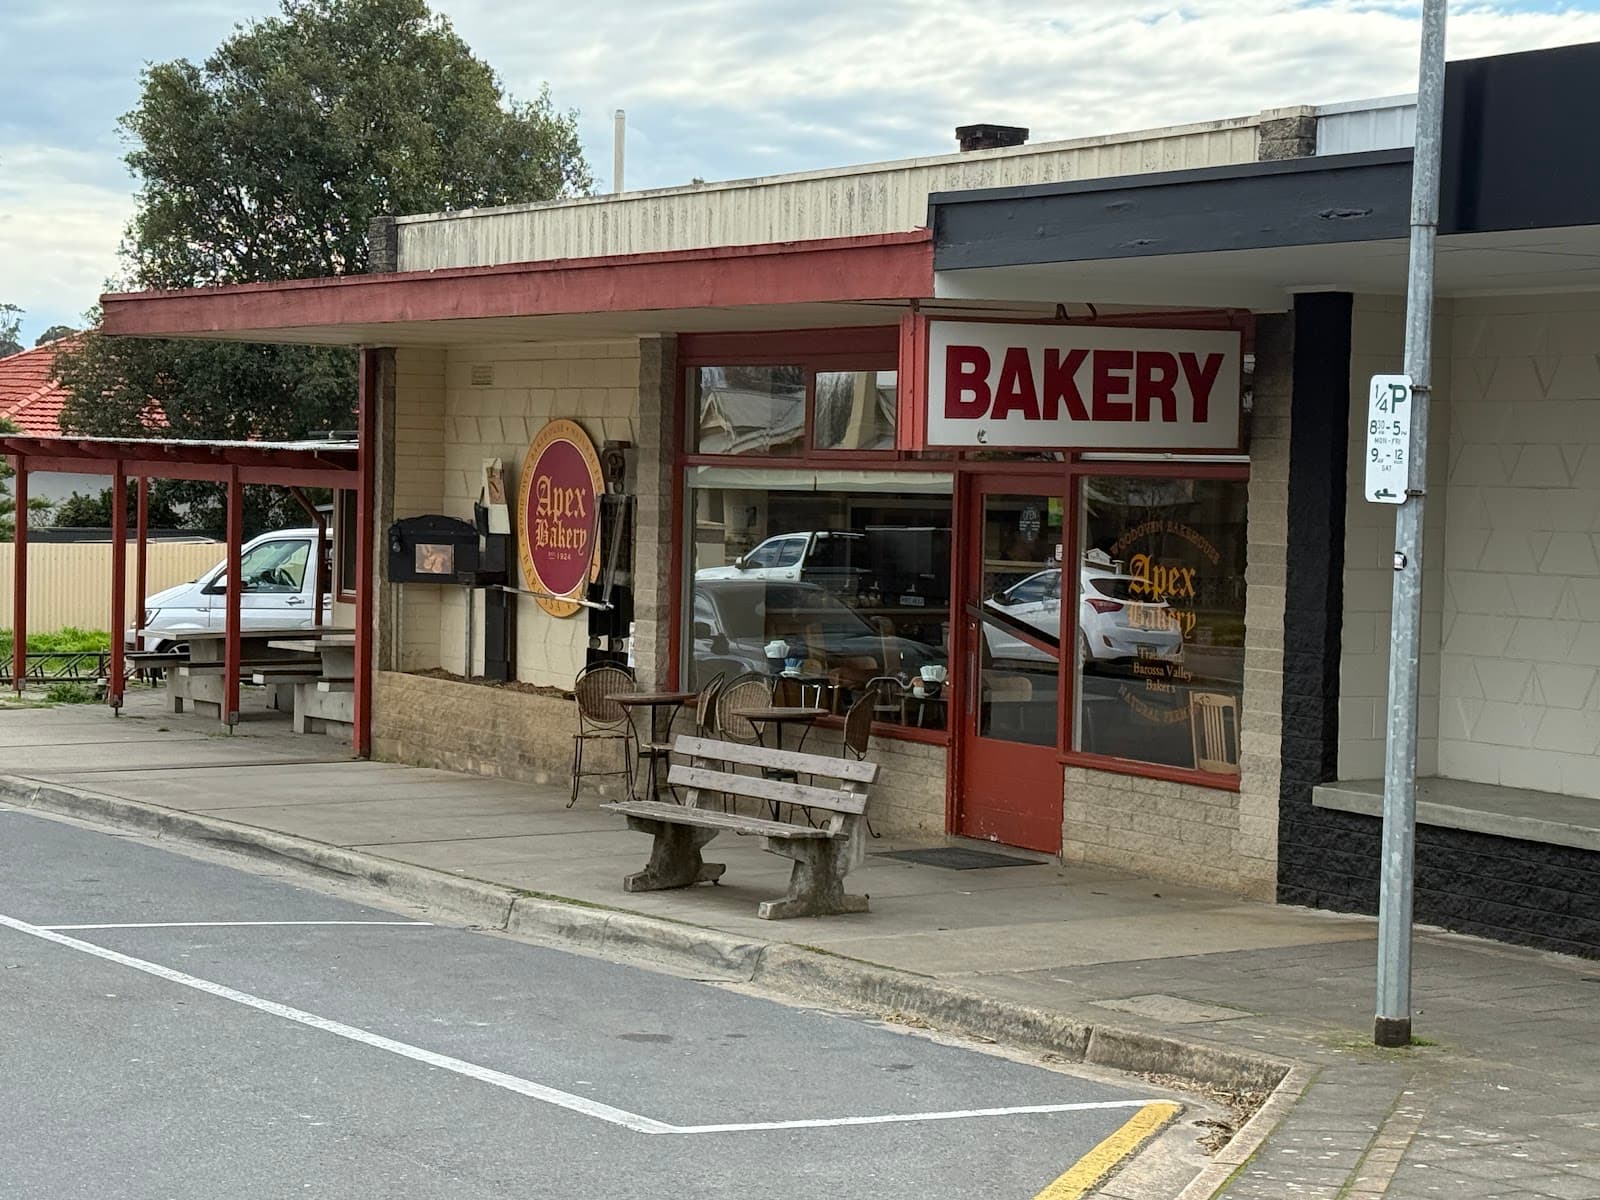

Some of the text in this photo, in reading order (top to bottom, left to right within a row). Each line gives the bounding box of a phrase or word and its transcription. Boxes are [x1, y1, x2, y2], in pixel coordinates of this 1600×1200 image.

[944, 345, 1225, 423] BAKERY
[535, 475, 586, 521] Apex
[535, 518, 587, 556] Bakery
[1128, 553, 1197, 602] Apex
[1127, 598, 1197, 639] Bakery
[1133, 662, 1192, 682] Barossa Valley
